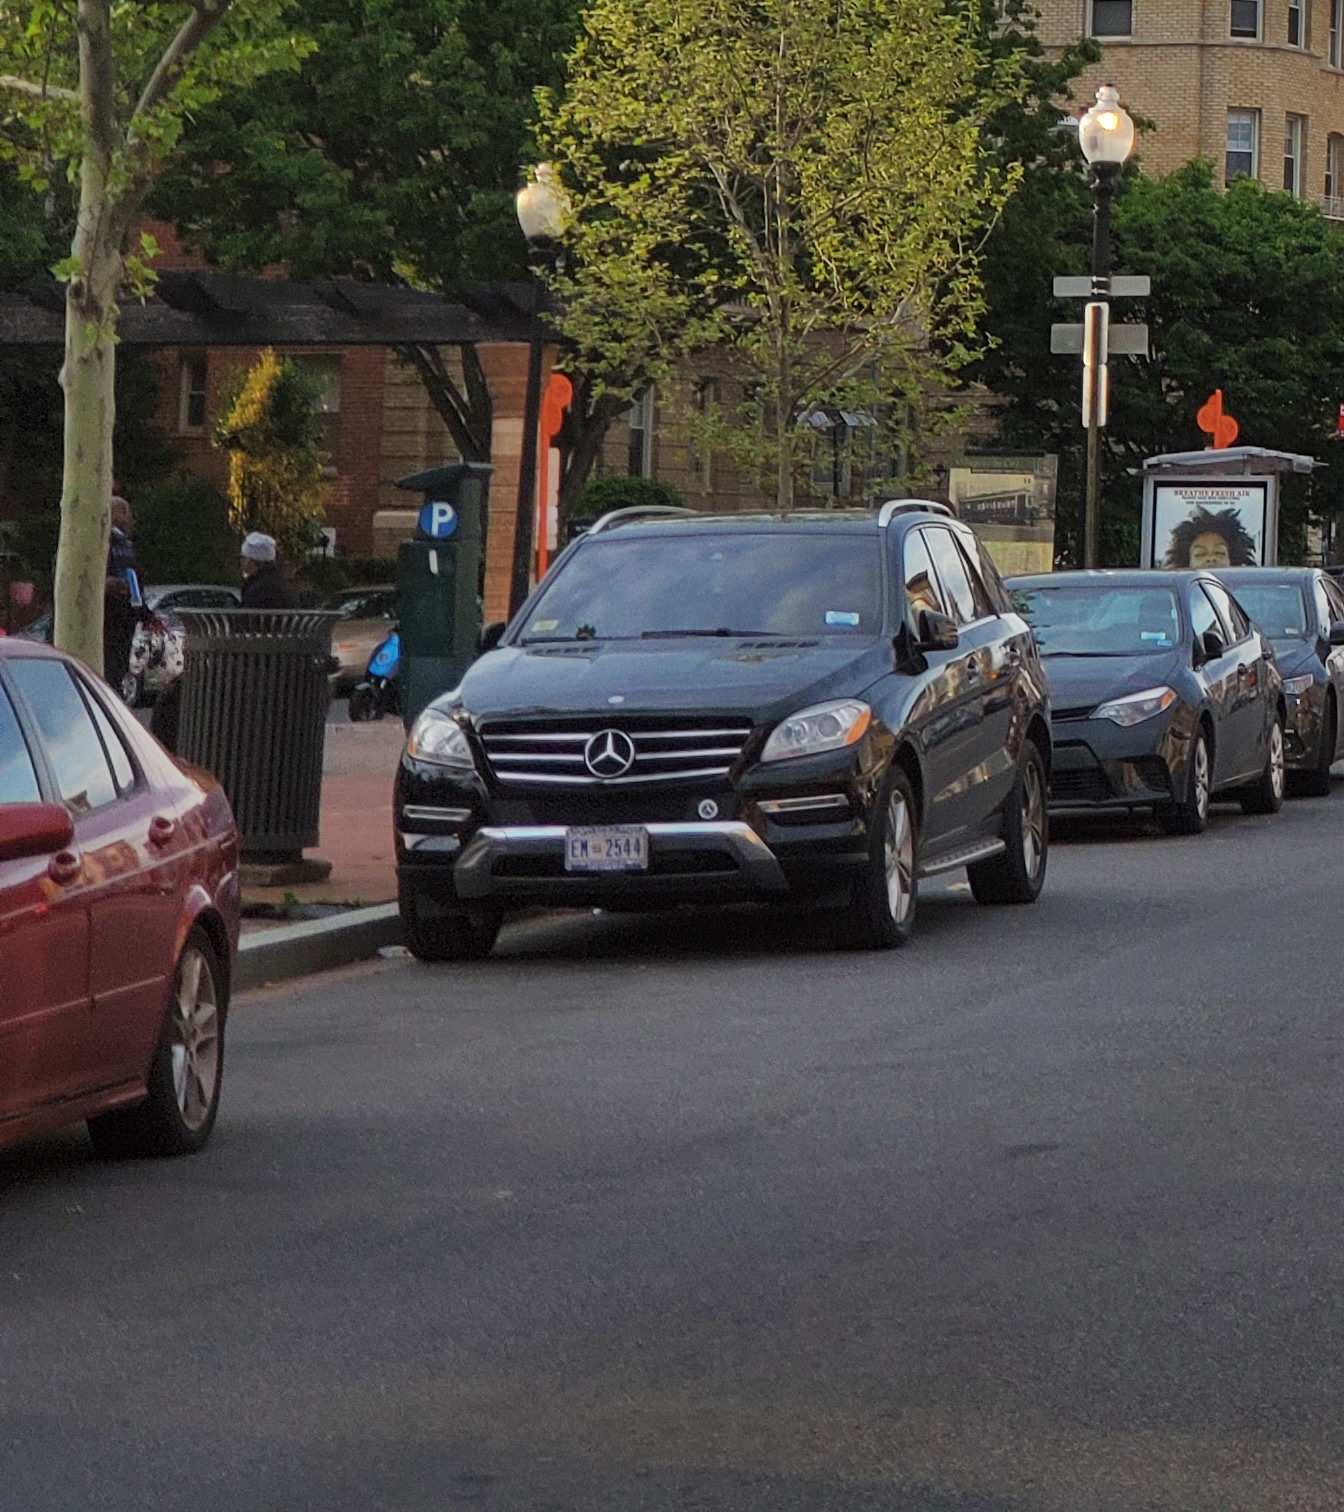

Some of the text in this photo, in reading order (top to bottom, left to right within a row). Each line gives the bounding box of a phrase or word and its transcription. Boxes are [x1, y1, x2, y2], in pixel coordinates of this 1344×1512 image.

[1174, 489, 1209, 497] BREATHE
[431, 500, 454, 537] P
[606, 837, 641, 858] 2544
